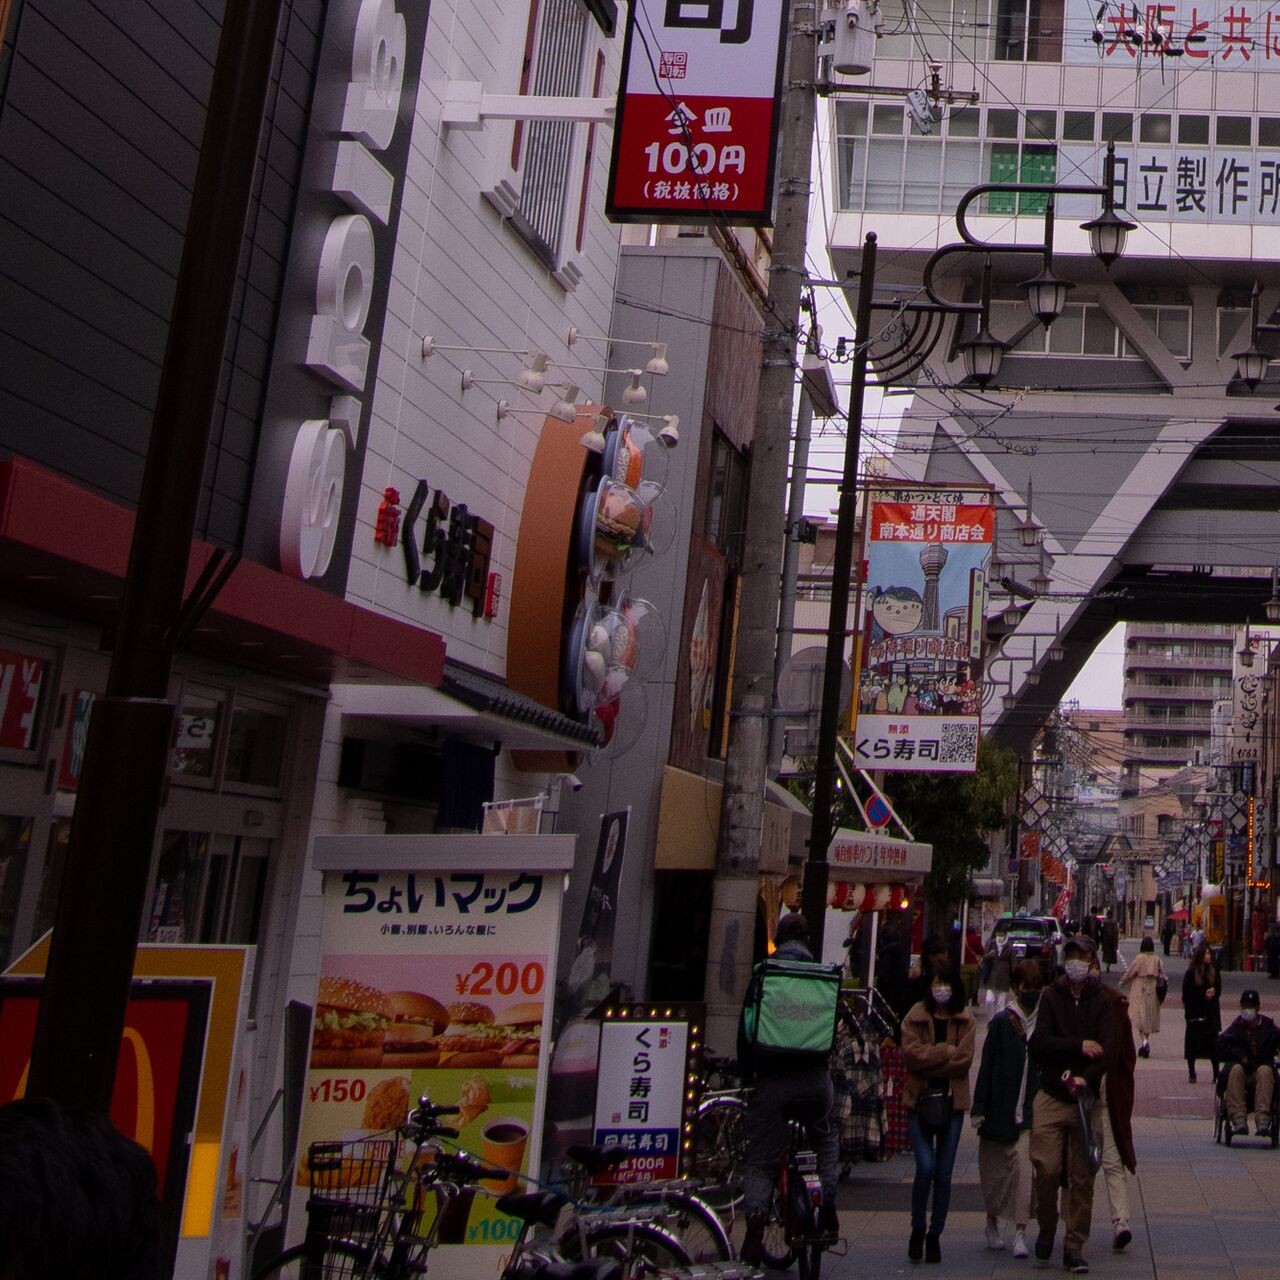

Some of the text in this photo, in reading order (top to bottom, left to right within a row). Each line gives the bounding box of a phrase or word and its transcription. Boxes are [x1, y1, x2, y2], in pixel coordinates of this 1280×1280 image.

[664, 101, 733, 135] 全皿
[644, 141, 746, 175] 100円
[910, 505, 956, 523] 通天閣
[879, 522, 986, 541] 南本通り商店会
[855, 738, 940, 761] くら寿司
[342, 869, 544, 914] ちょいマック
[455, 961, 545, 996] ¥200
[627, 1026, 652, 1124] くら寿司
[310, 1079, 366, 1104] ¥150
[604, 1132, 669, 1152] 回転寿司
